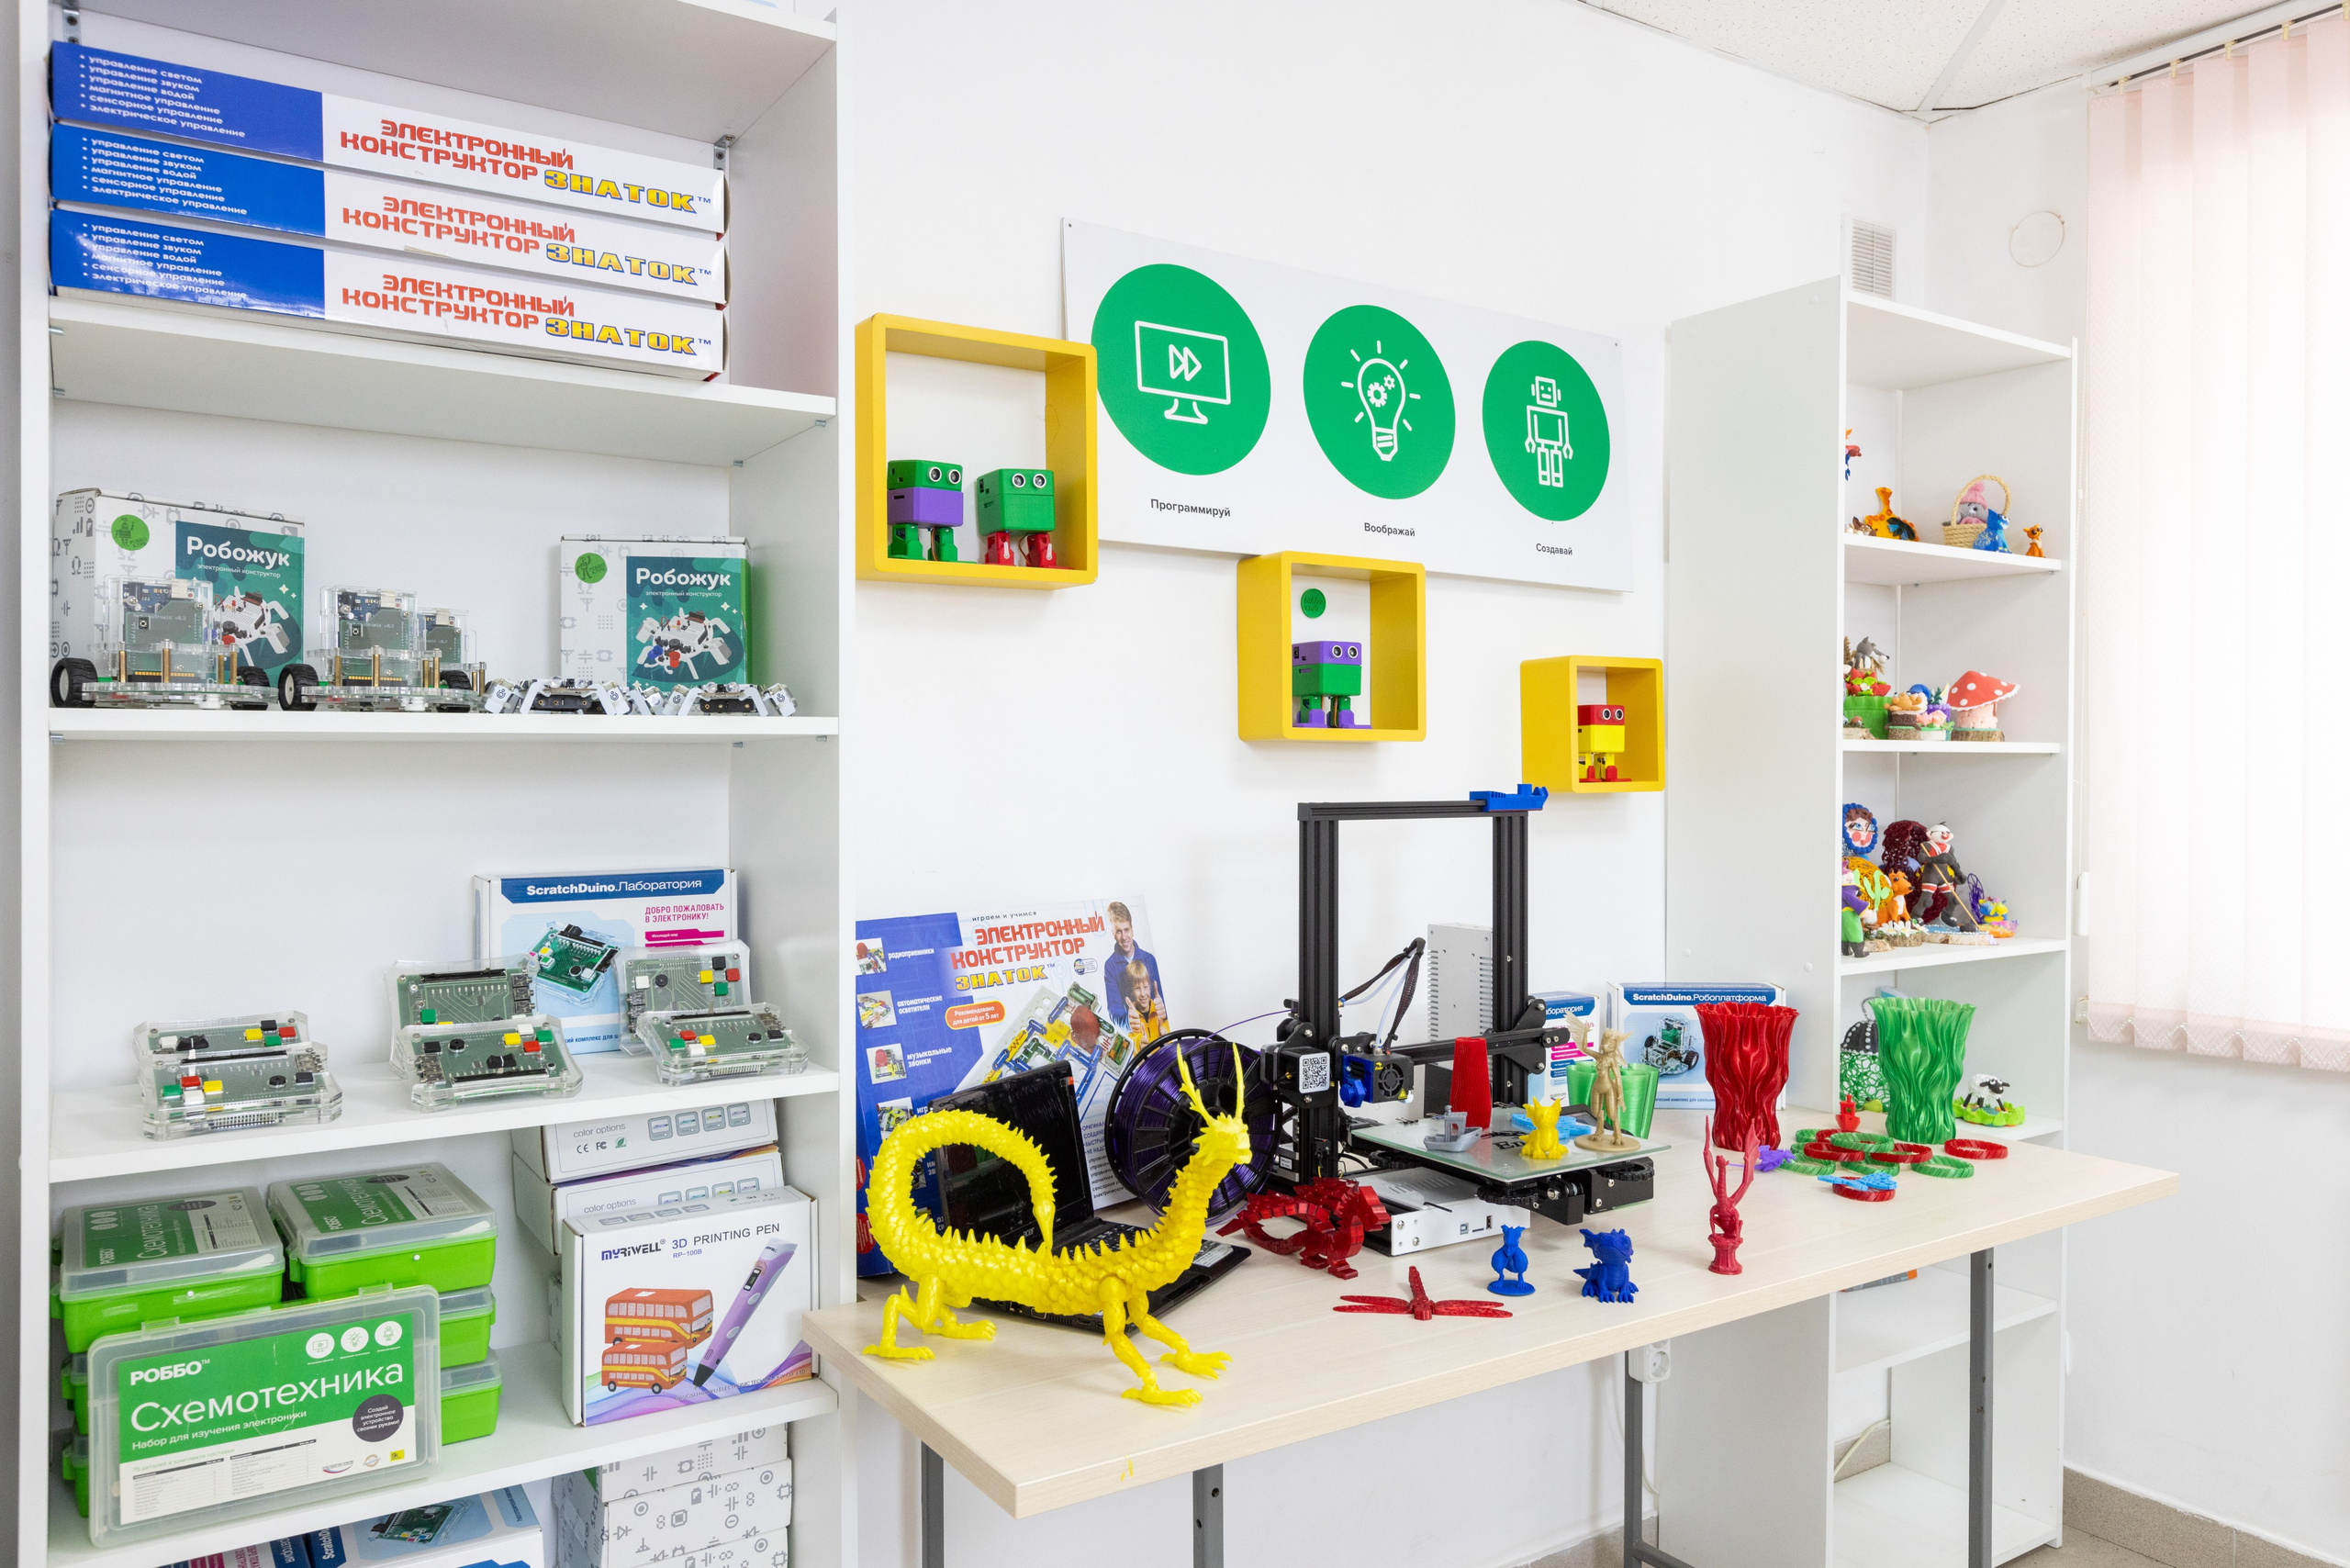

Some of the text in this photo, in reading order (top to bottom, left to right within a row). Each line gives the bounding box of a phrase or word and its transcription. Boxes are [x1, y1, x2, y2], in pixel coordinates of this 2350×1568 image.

[88, 56, 202, 84] управление светом
[89, 65, 199, 93] управление звуком
[89, 74, 195, 100] управление водой
[90, 85, 220, 115] магнитное управление
[90, 95, 222, 124] сенсорное управление
[90, 105, 245, 138] электрическое управление
[91, 139, 204, 163] управление светом
[340, 131, 538, 181] КОНСТРУКТОР
[381, 118, 574, 171] ЭЛЕКТРОННЫЙ
[91, 148, 201, 172] управление звуком
[91, 157, 196, 179] управление водой
[91, 167, 222, 193] магнитное управление
[92, 176, 225, 202] сенсорное управление
[92, 186, 247, 215] электрическое управление
[342, 207, 540, 254] КОНСТРУКТОР
[383, 196, 576, 243] ЭЛЕКТРОННЫЙ
[92, 224, 204, 246] управление светом
[92, 233, 201, 255] управление звуком
[92, 243, 196, 263] управление водой
[92, 263, 225, 286] сенсорное управление
[92, 273, 247, 298] электрическое управление
[383, 274, 575, 318] ЭЛЕКТРОННЫЙ
[342, 287, 539, 330] КОНСТРУКТОР
[1150, 498, 1231, 518] Программируй
[1364, 521, 1416, 538] Воображай
[186, 536, 289, 569] Робожук
[1536, 543, 1572, 556] Создавай
[196, 564, 281, 578] электронный конструктор
[636, 567, 731, 590] Робожук
[527, 879, 701, 896] ScratchDuino.Лаборатория
[645, 902, 724, 915] ДОБРО ПОЖАЛОВАТЬ
[653, 913, 709, 923] ЭЛЕКТРОНИКУ!
[975, 911, 1104, 946] ЭЛЕКТРОННЫЙ
[889, 948, 934, 960] радиоприемники
[951, 937, 1084, 969] КОНСТРУКТОР
[897, 995, 943, 1007] автоматические
[899, 1004, 930, 1014] осветители
[1633, 993, 1766, 1002] ScratchDuino.Робоплатформа
[955, 1006, 994, 1016] Рекомендовано
[907, 1047, 952, 1060] музыкальные
[909, 1058, 931, 1067] звонки
[574, 1123, 626, 1138] color options
[1084, 1129, 1104, 1138] СОЕДИНЕ
[584, 1198, 636, 1214] color options
[672, 1239, 688, 1249] 3D
[694, 1228, 751, 1246] PRINTING
[756, 1224, 779, 1235] PEN
[1024, 1227, 1035, 1237] acer
[130, 1362, 404, 1433] Схемотехника
[361, 1410, 396, 1420] электронное
[363, 1416, 394, 1427] устройство
[378, 1419, 399, 1428] руками!
[132, 1409, 307, 1451] Набор для изучения электроники
